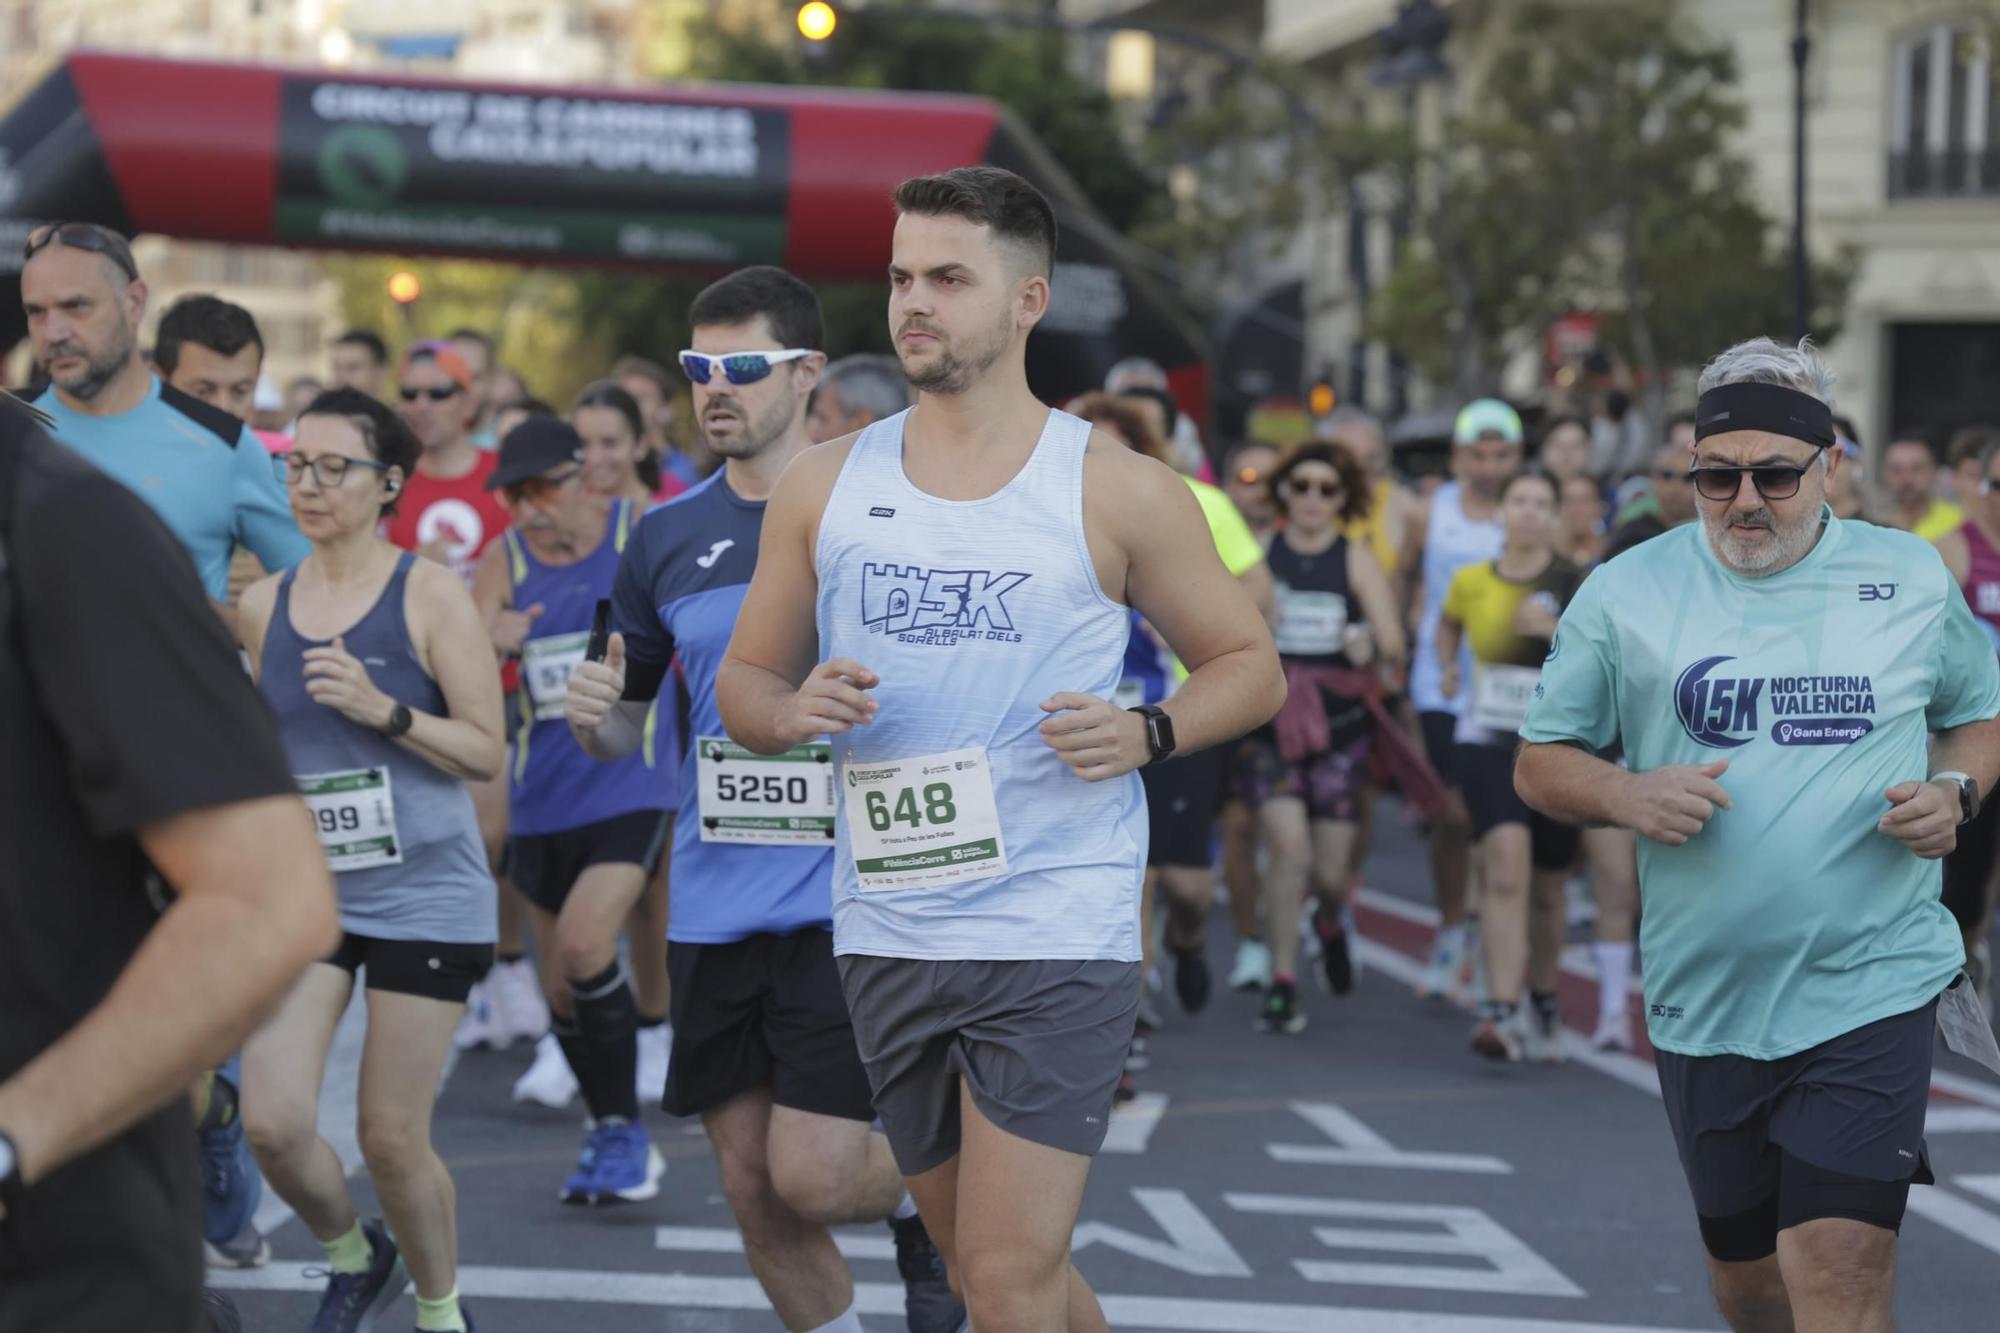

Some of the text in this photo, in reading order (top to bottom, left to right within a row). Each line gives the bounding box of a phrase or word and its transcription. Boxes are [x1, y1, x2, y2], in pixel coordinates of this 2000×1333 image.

[312, 81, 472, 124] CIRCUIT
[897, 633, 958, 646] SORELLS
[925, 628, 1023, 643] ALBALAT DELS
[1770, 676, 1872, 694] NOCTURNA
[1691, 678, 1766, 732] 15K
[1771, 694, 1876, 715] VALENCIA
[1793, 726, 1867, 740] Gana Energía
[717, 774, 807, 804] 5250
[313, 805, 360, 833] 99
[865, 782, 957, 832] 648
